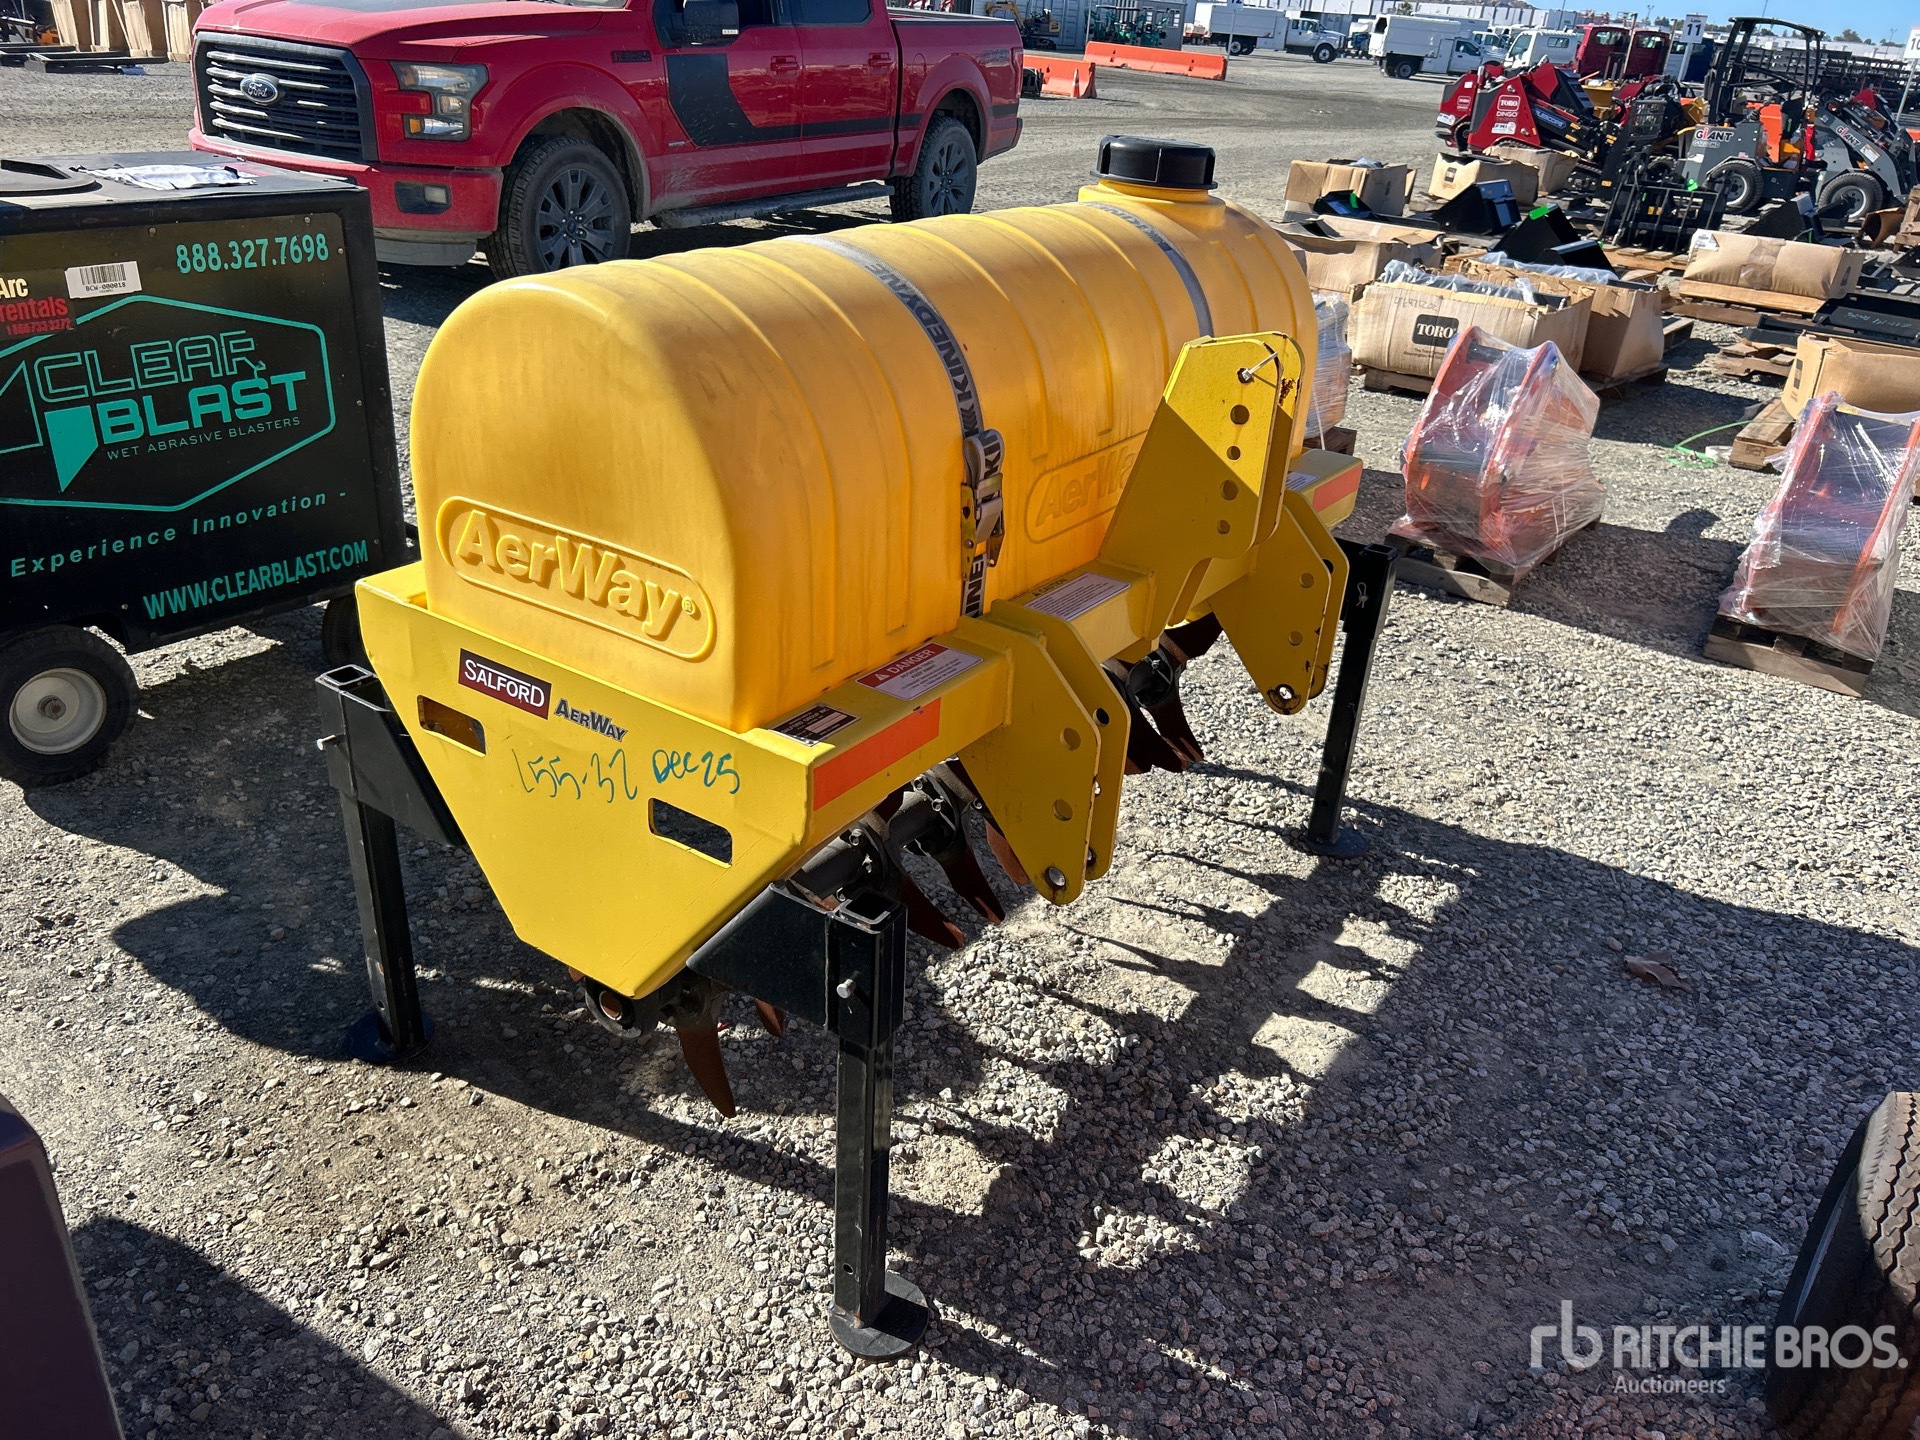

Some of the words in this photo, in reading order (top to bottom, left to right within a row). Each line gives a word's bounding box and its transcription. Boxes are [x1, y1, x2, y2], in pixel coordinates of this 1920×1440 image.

[1687, 24, 1701, 36] 11
[248, 82, 268, 97] Ford
[176, 233, 329, 274] 888.327.7698
[85, 282, 126, 292] BCW-000018
[34, 330, 260, 402] CLEAR
[96, 371, 306, 444] BLAST
[107, 445, 139, 460] WET
[147, 432, 223, 453] ABRASIVE
[229, 417, 300, 438] BLASTERS
[11, 527, 177, 577] Experience
[193, 491, 326, 535] Innovation
[143, 540, 368, 620] WWW.CLEARBLAST.COM
[886, 649, 936, 674] DANGER
[464, 659, 545, 708] SALFORD
